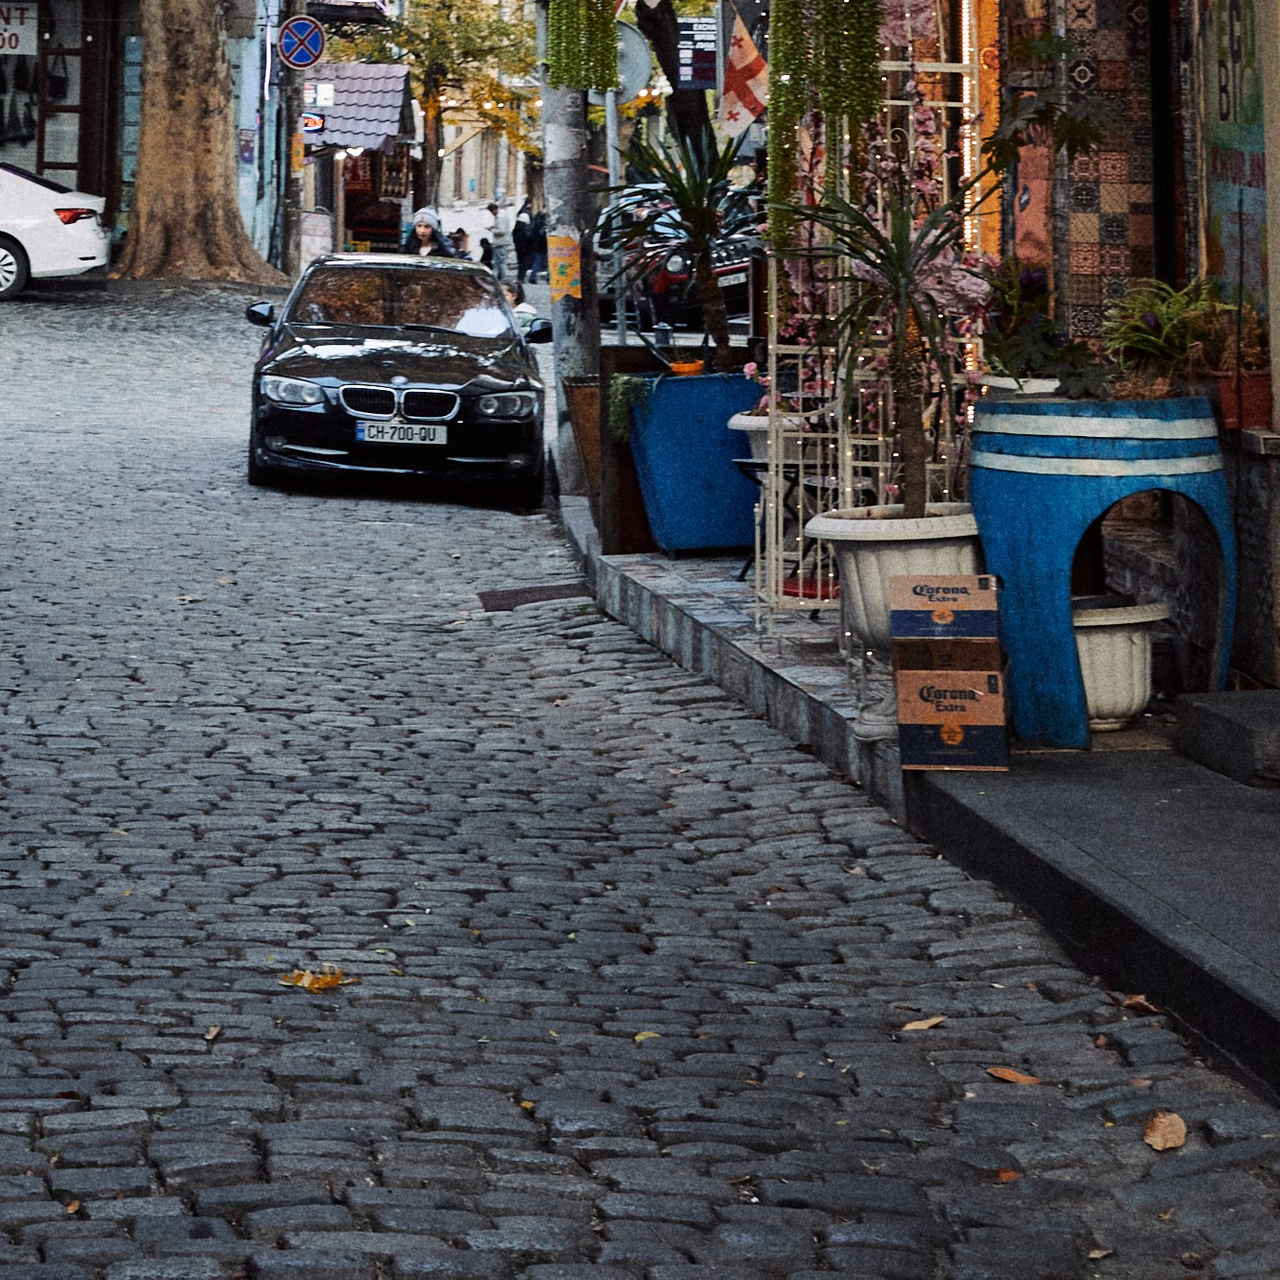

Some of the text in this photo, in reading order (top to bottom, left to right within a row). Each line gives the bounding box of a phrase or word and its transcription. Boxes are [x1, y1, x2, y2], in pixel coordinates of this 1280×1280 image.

[367, 424, 436, 442] CH-700-QU
[911, 583, 970, 597] Corona
[928, 594, 959, 603] Extra
[918, 684, 979, 703] Corona
[934, 700, 967, 713] Extra
